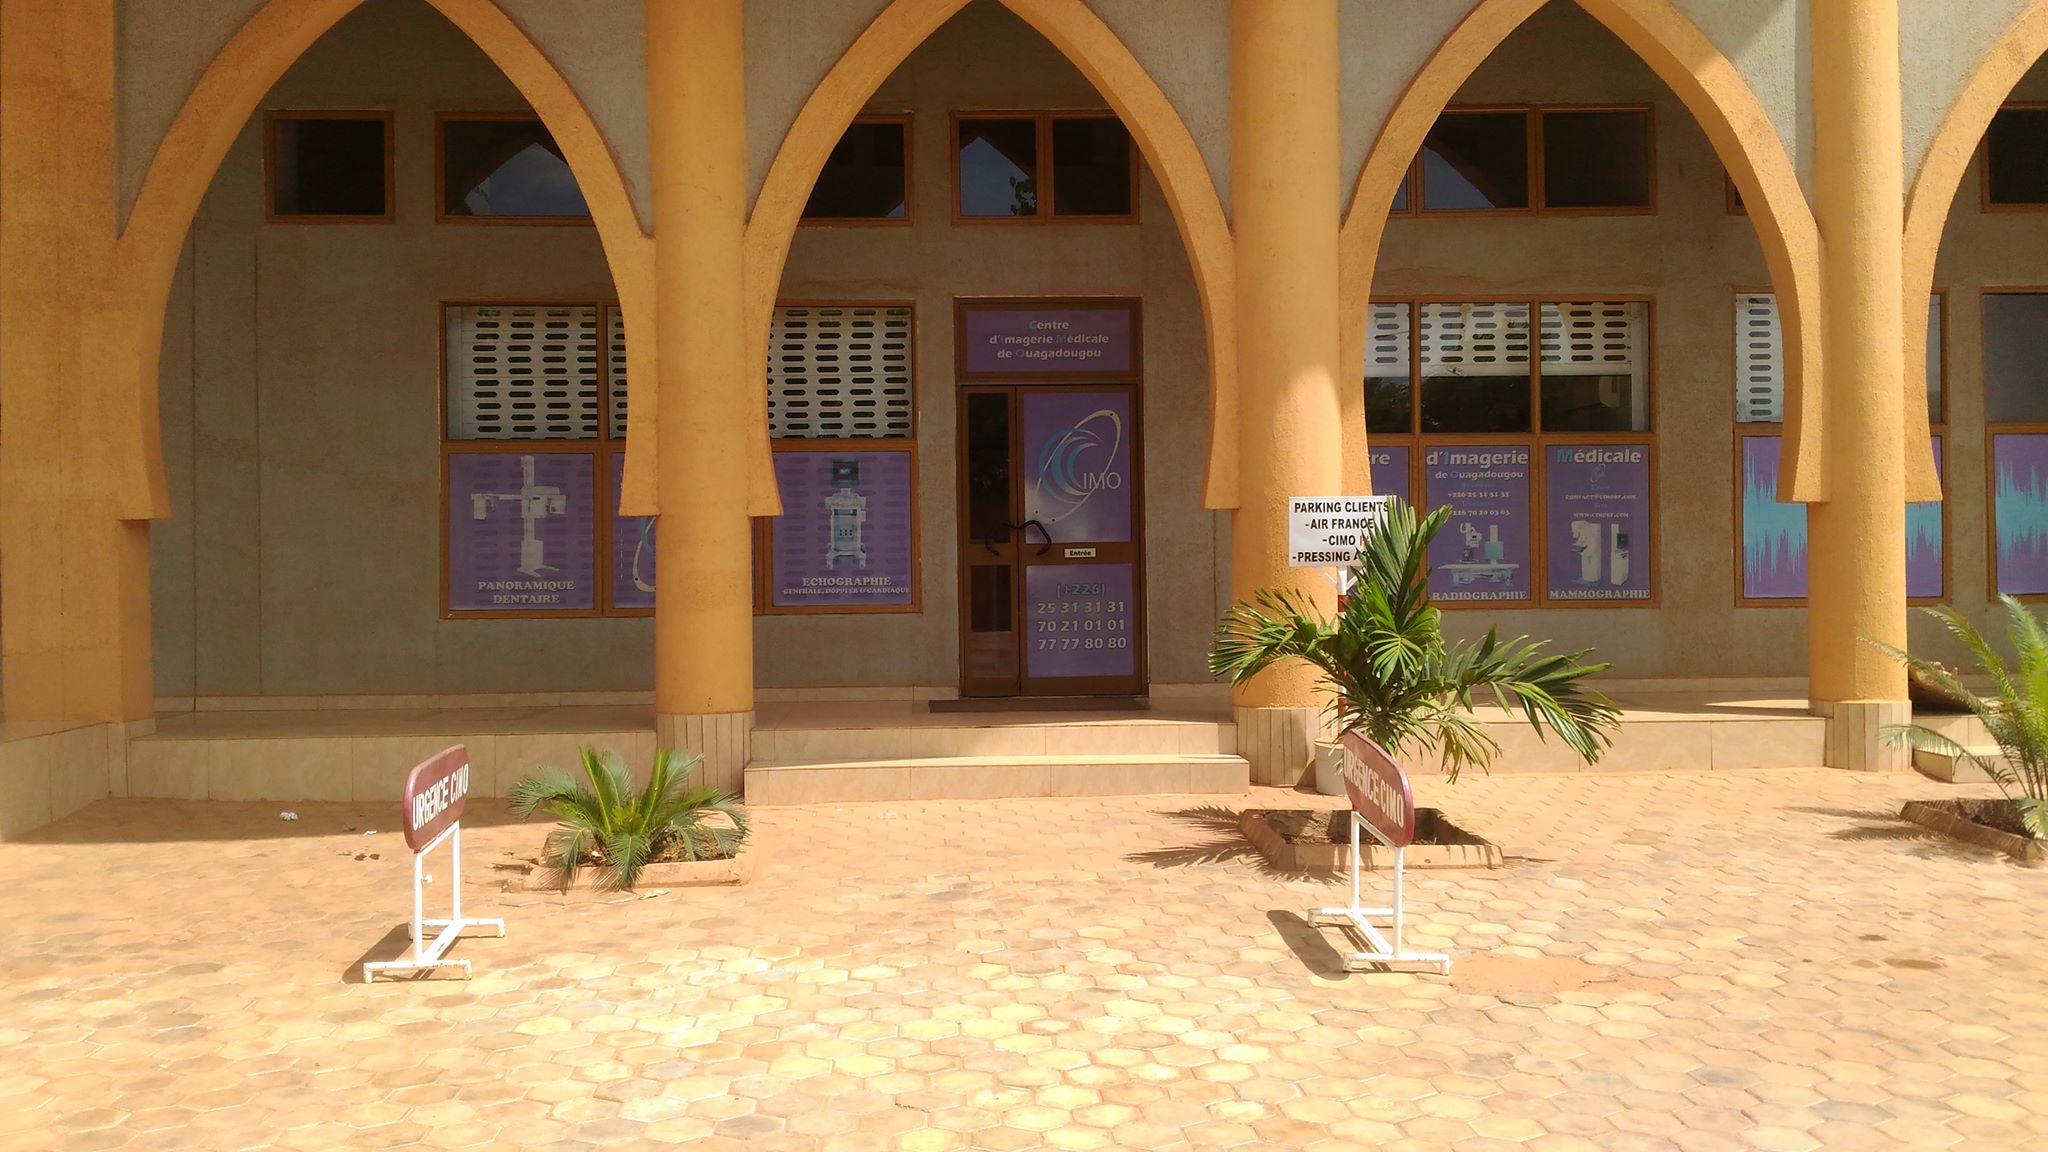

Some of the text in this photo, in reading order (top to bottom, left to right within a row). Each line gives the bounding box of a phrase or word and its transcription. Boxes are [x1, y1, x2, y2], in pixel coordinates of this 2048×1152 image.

[1029, 320, 1069, 330] Centre
[1056, 334, 1109, 344] Médicale
[997, 348, 1101, 360] de Ouagadougou
[1557, 448, 1641, 463] Médicale
[1435, 470, 1523, 480] de Ouagadougou
[1294, 501, 1389, 513] PARKING CLIENTS
[1332, 518, 1375, 529] FRANCE
[478, 580, 575, 591] PANORAMIQUE
[802, 576, 892, 587] ECHOGRAPHIE
[493, 594, 560, 604] DENTAIRE
[1431, 591, 1527, 601] RADIOGRAPHIE
[1549, 589, 1650, 600] MAMMOGRAPHIE
[1038, 601, 1124, 613] 25 31 31 31
[1038, 619, 1125, 632] 70 21 01 01
[1038, 637, 1127, 650] 77 77 80 80
[1343, 746, 1404, 828] URGENCE CIMO
[412, 763, 469, 831] URGENCE CIMO
